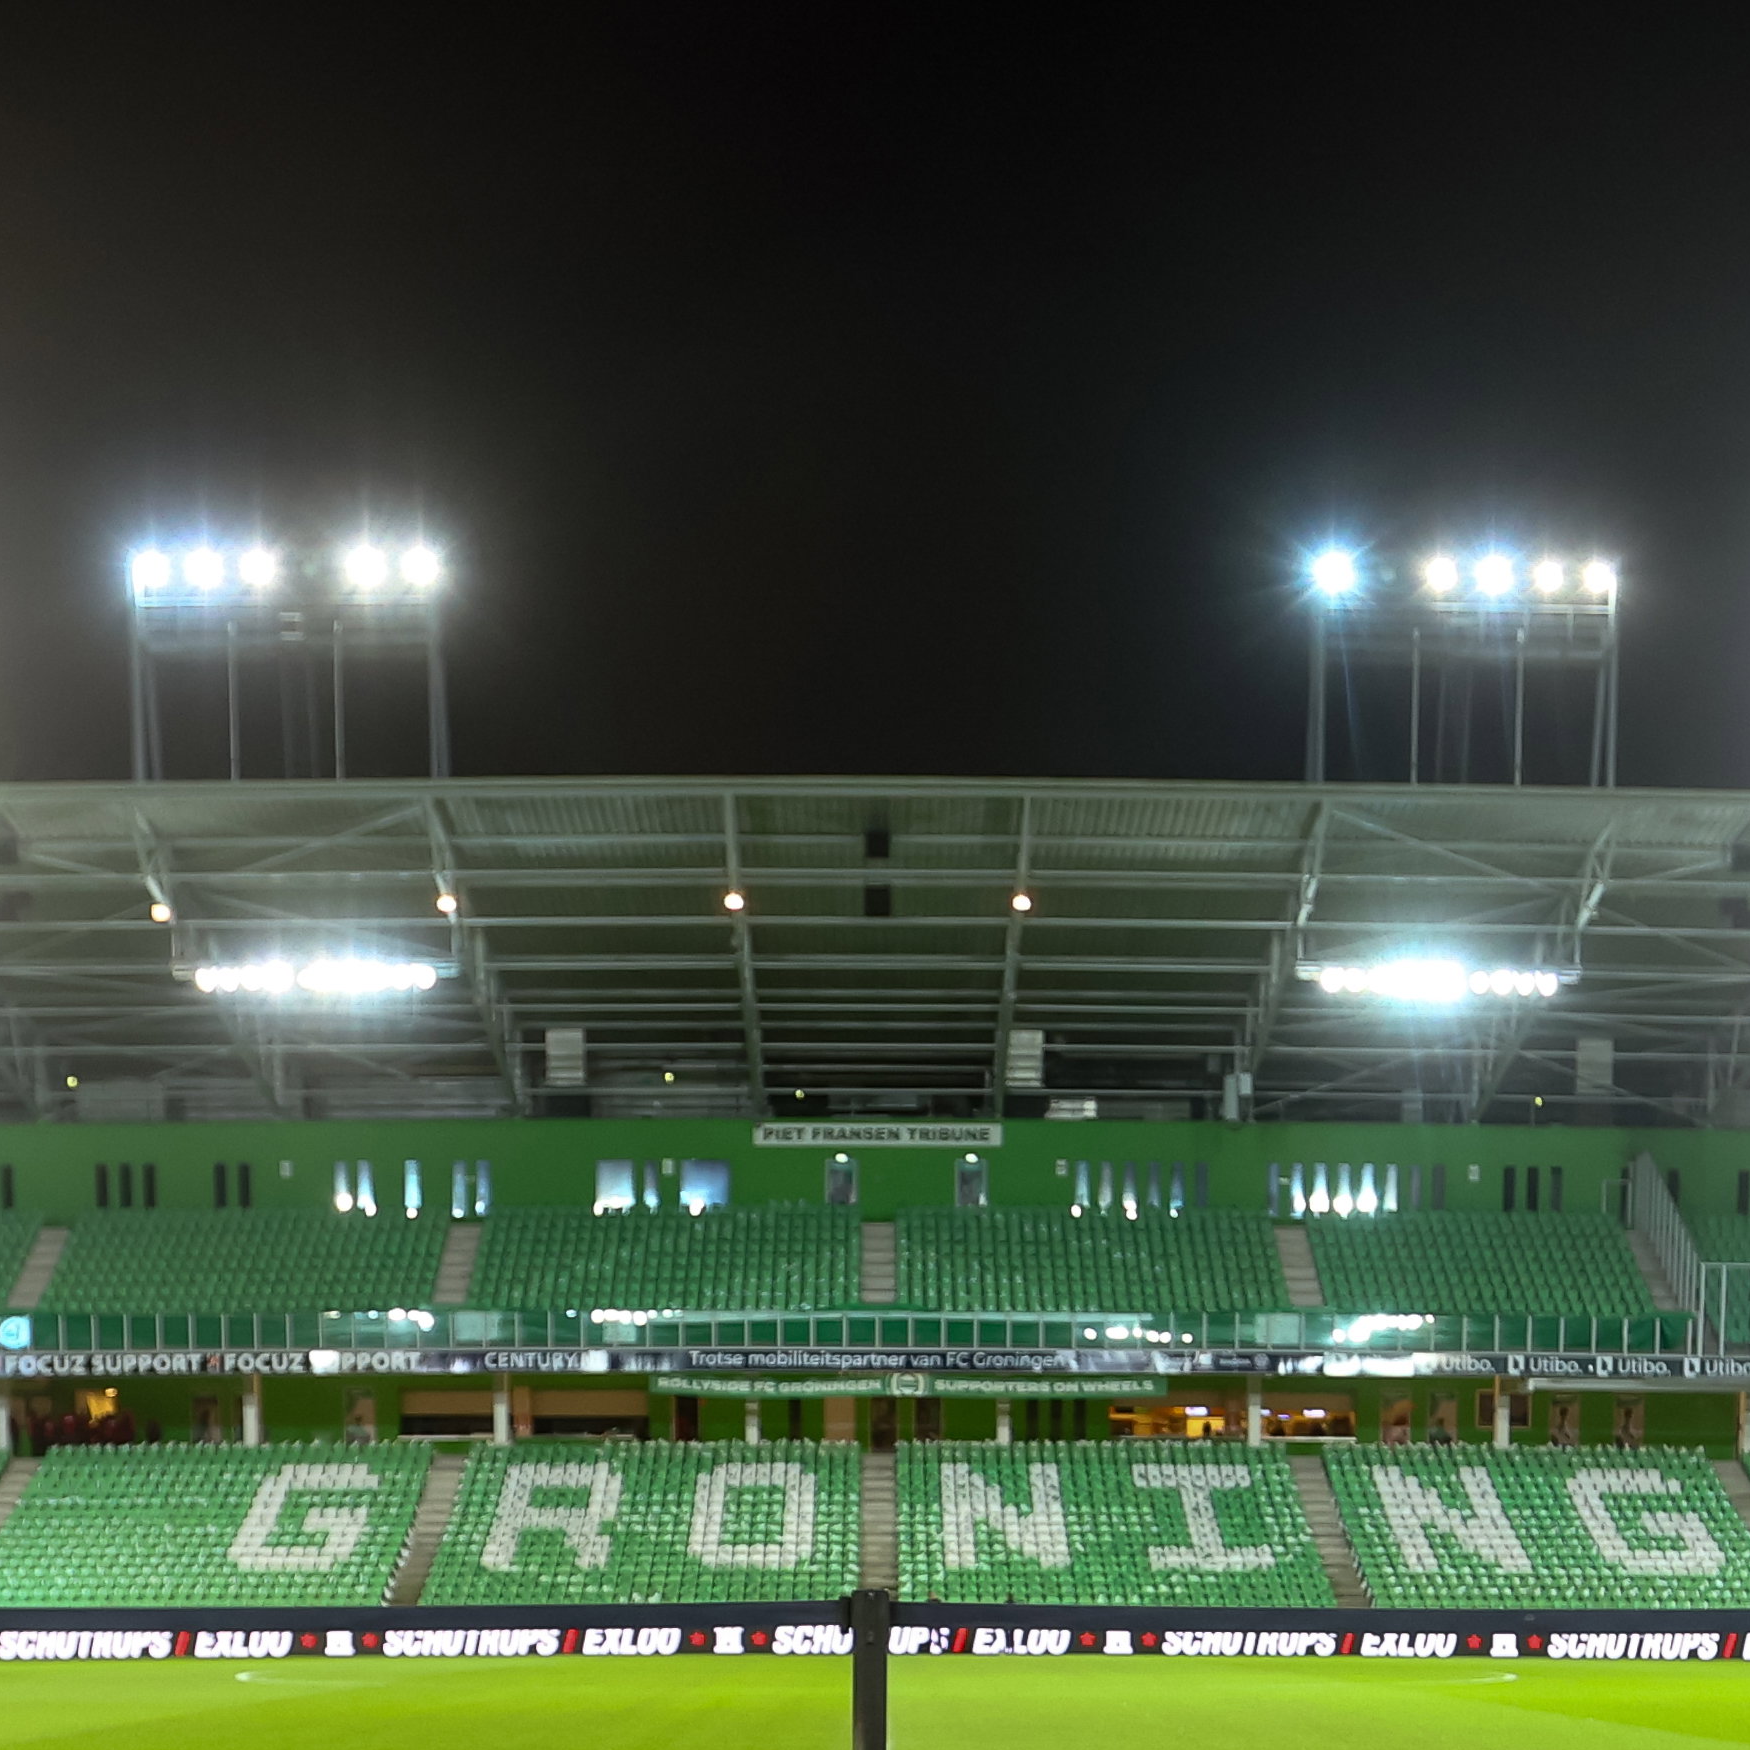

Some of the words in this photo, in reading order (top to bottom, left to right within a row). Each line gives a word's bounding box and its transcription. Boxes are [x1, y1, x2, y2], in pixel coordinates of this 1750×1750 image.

[762, 1126, 805, 1142] PIET
[811, 1126, 901, 1142] FRANSEN
[907, 1126, 991, 1142] TRIBUNE
[4, 1352, 87, 1376] FOCUZ
[90, 1352, 201, 1375] SUPPORT
[224, 1352, 306, 1374] FOCUZ
[308, 1350, 421, 1374] PPORT
[689, 1350, 744, 1367] Trotse
[749, 1350, 906, 1371] mobiliteitspartner
[911, 1353, 942, 1367] van
[946, 1352, 970, 1368] FC
[934, 1379, 1050, 1393] SUPPORTERS
[1082, 1379, 1155, 1392] WHEELS
[581, 1627, 682, 1656] EXLOO
